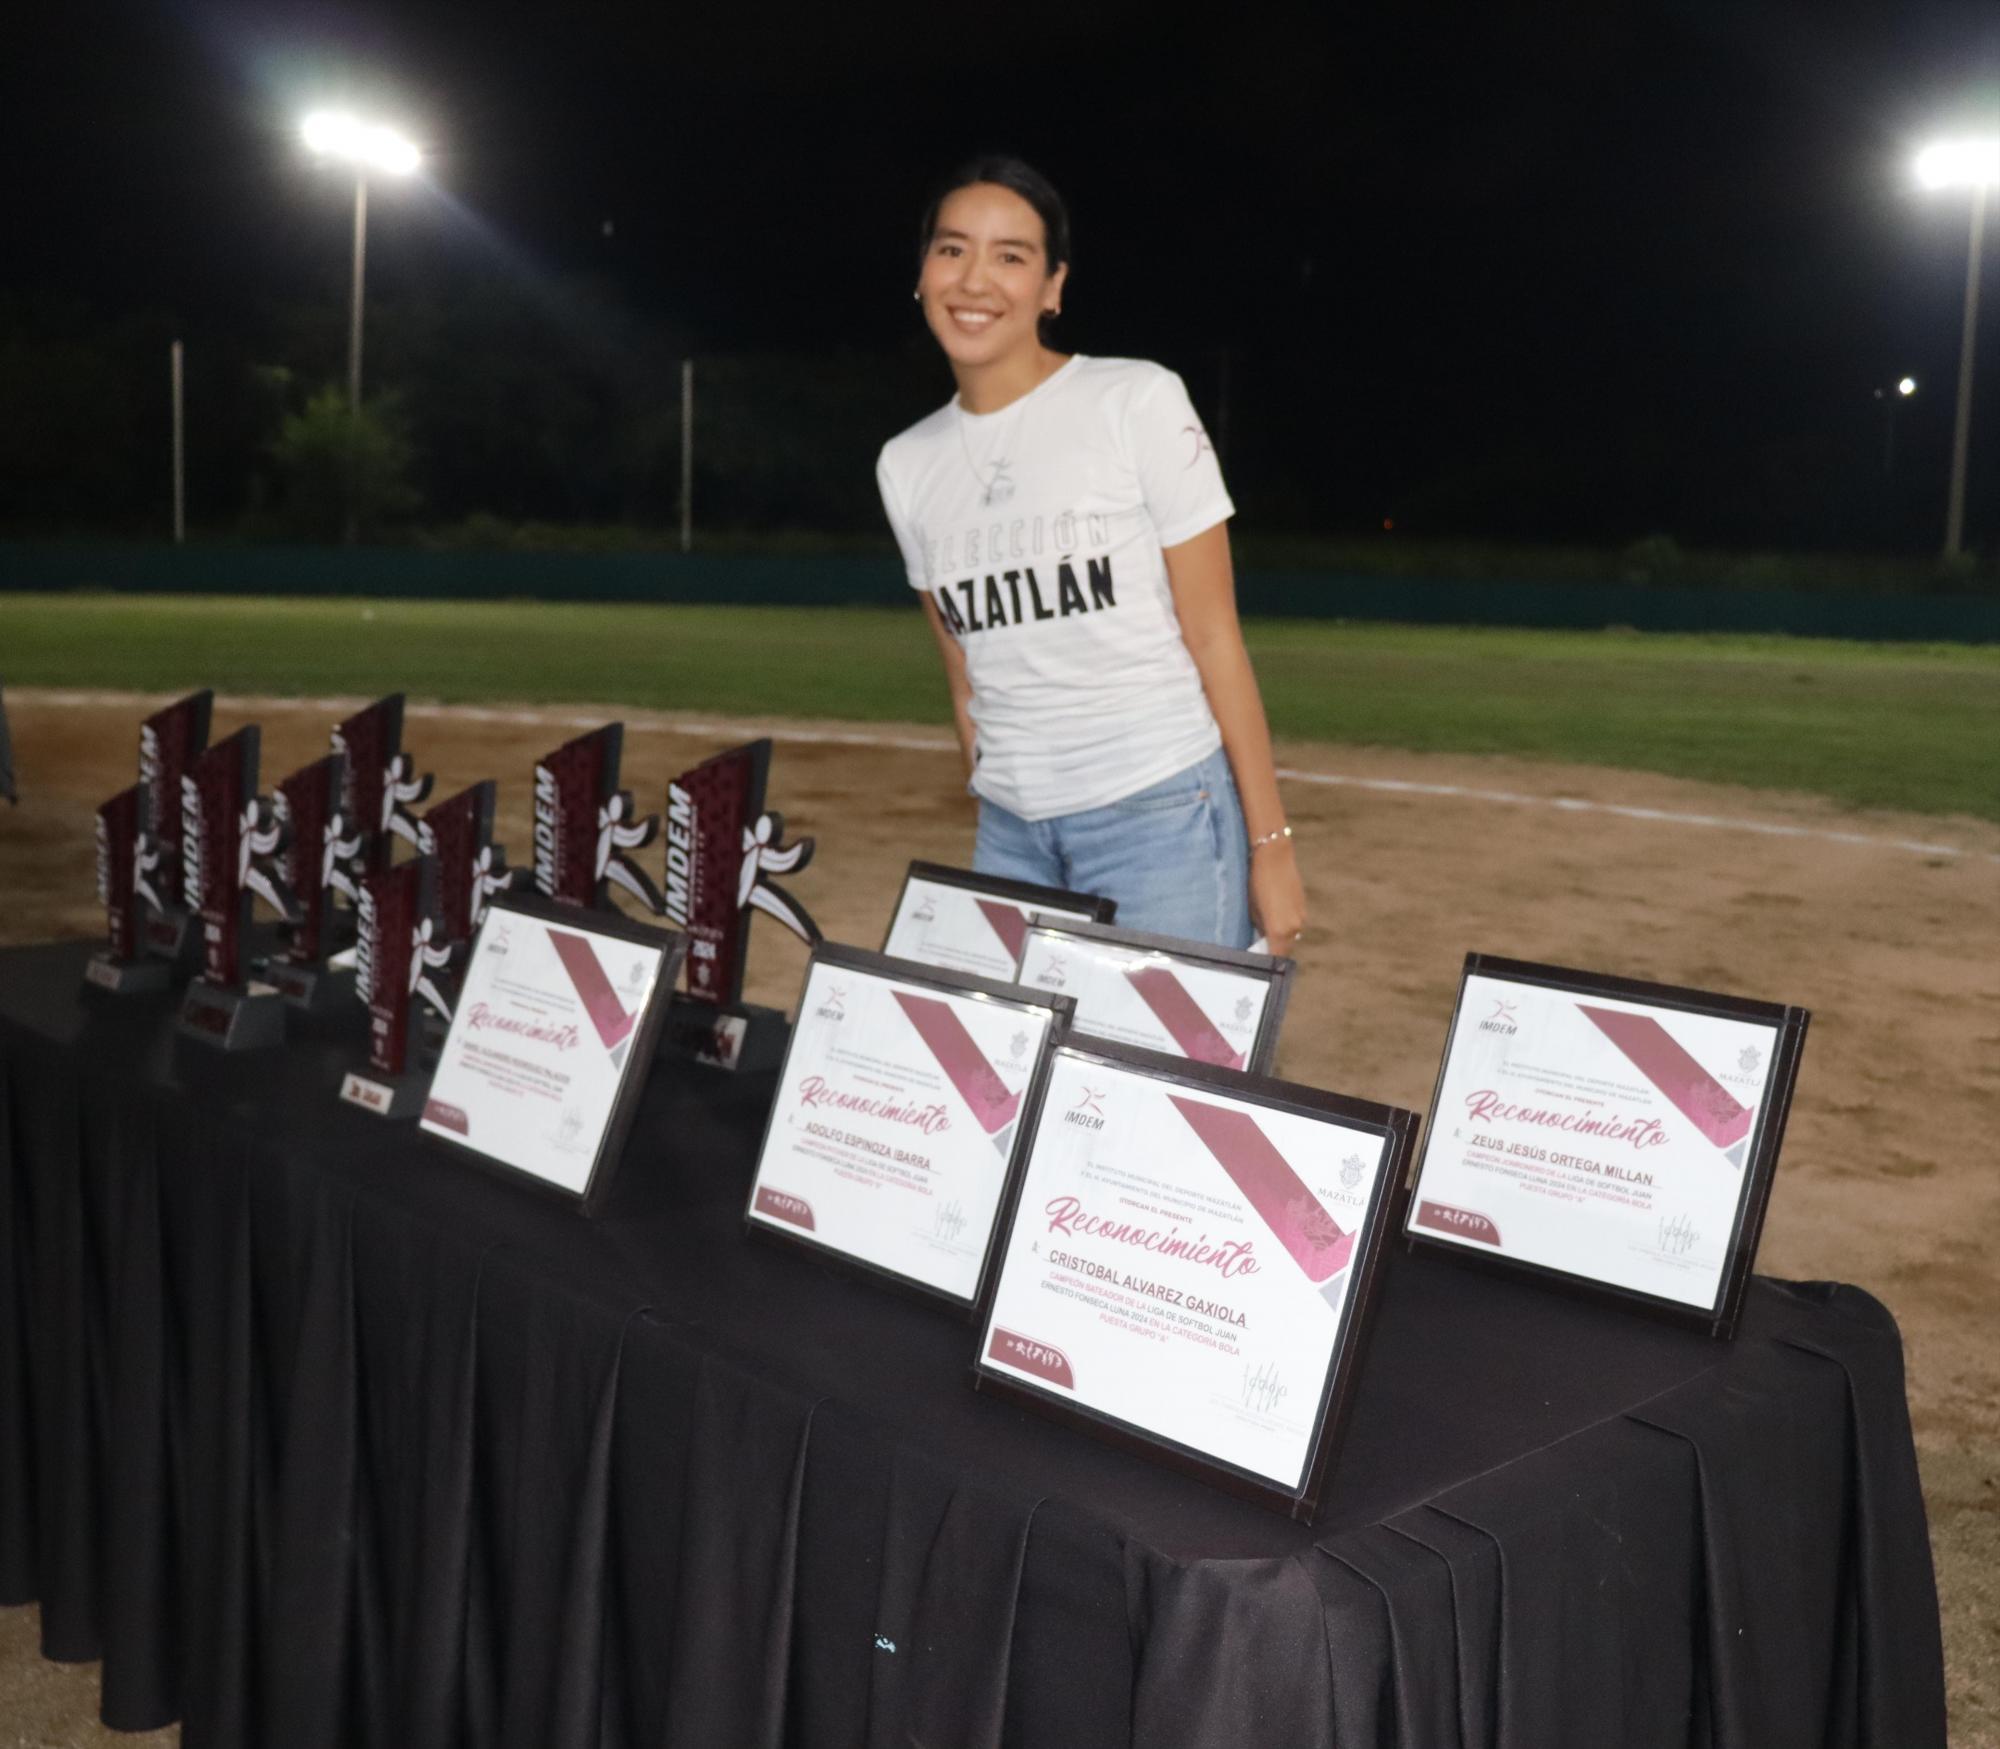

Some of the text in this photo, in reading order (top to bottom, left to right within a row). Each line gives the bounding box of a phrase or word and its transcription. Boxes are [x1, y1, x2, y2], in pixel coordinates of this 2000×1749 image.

[925, 509, 1110, 580] ELECCIÓN
[939, 555, 1118, 637] AZATLÁN
[535, 765, 555, 896] IMDEM
[664, 782, 691, 926] IMDEM
[1479, 1020, 1518, 1037] IMDEM
[799, 1076, 951, 1135] Reconocimiento
[1064, 1109, 1105, 1131] IMDEM
[1465, 1090, 1669, 1150] Reconocimiento
[805, 1121, 843, 1142] ADOLFO
[844, 1133, 891, 1157] ESPINOZA
[893, 1148, 932, 1169] IBARRA
[1471, 1133, 1653, 1186] ZEUS JESÚS ORTEGA MILLAN
[1160, 1207, 1193, 1225] PRESENTE
[1175, 1185, 1205, 1201] DEPORTE
[1045, 1196, 1261, 1278] Reconocimiento
[1040, 1280, 1074, 1298] ERNESTO
[1074, 1291, 1109, 1310] FONSECA
[1109, 1304, 1130, 1317] LUNA
[1130, 1311, 1148, 1323] 2024
[1149, 1318, 1160, 1328] EN
[1161, 1322, 1171, 1332] LA
[1218, 1341, 1240, 1356] BOLA
[1050, 1249, 1246, 1328] CRISTOBAL ALVAREZ GAXIOLA
[1086, 1283, 1124, 1302] BATEADOR
[1125, 1296, 1135, 1307] DE
[1136, 1300, 1146, 1311] LA
[1147, 1305, 1164, 1317] LIGA
[1166, 1311, 1177, 1321] DE
[1178, 1314, 1214, 1334] SOFTBOL
[1215, 1328, 1238, 1342] JUAN
[1099, 1312, 1128, 1329] PUESTA
[1129, 1322, 1156, 1339] GRUPO
